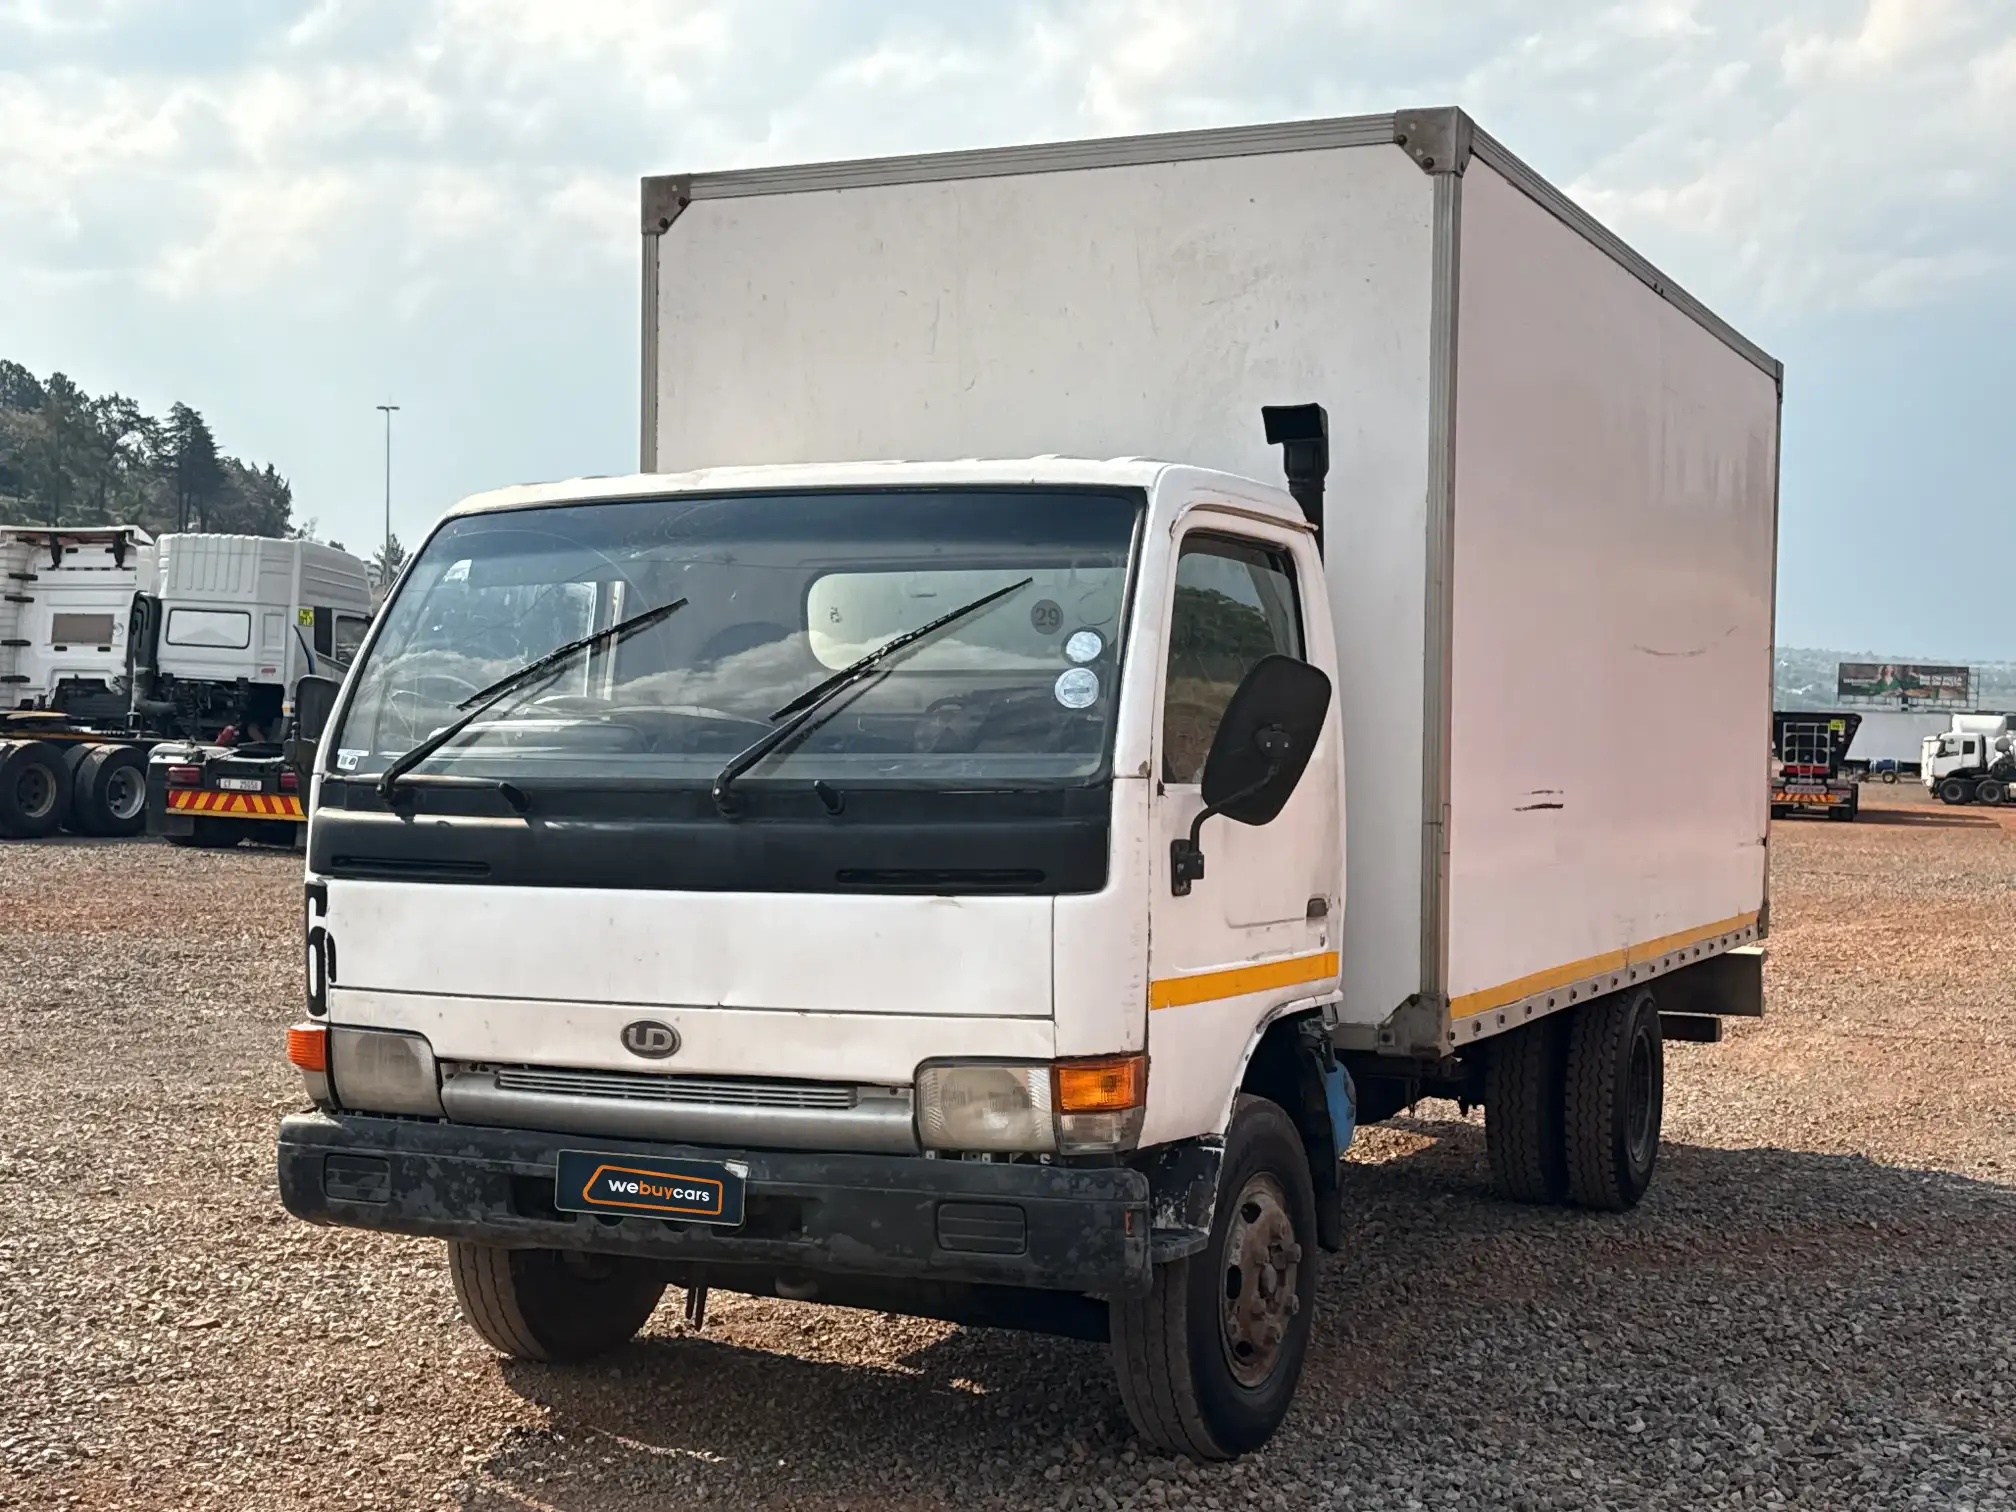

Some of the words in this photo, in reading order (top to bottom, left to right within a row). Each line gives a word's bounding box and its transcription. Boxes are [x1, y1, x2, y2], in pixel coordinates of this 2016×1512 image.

[1035, 607, 1060, 627] 29
[628, 1027, 673, 1051] UD
[608, 1179, 710, 1202] webuycars
